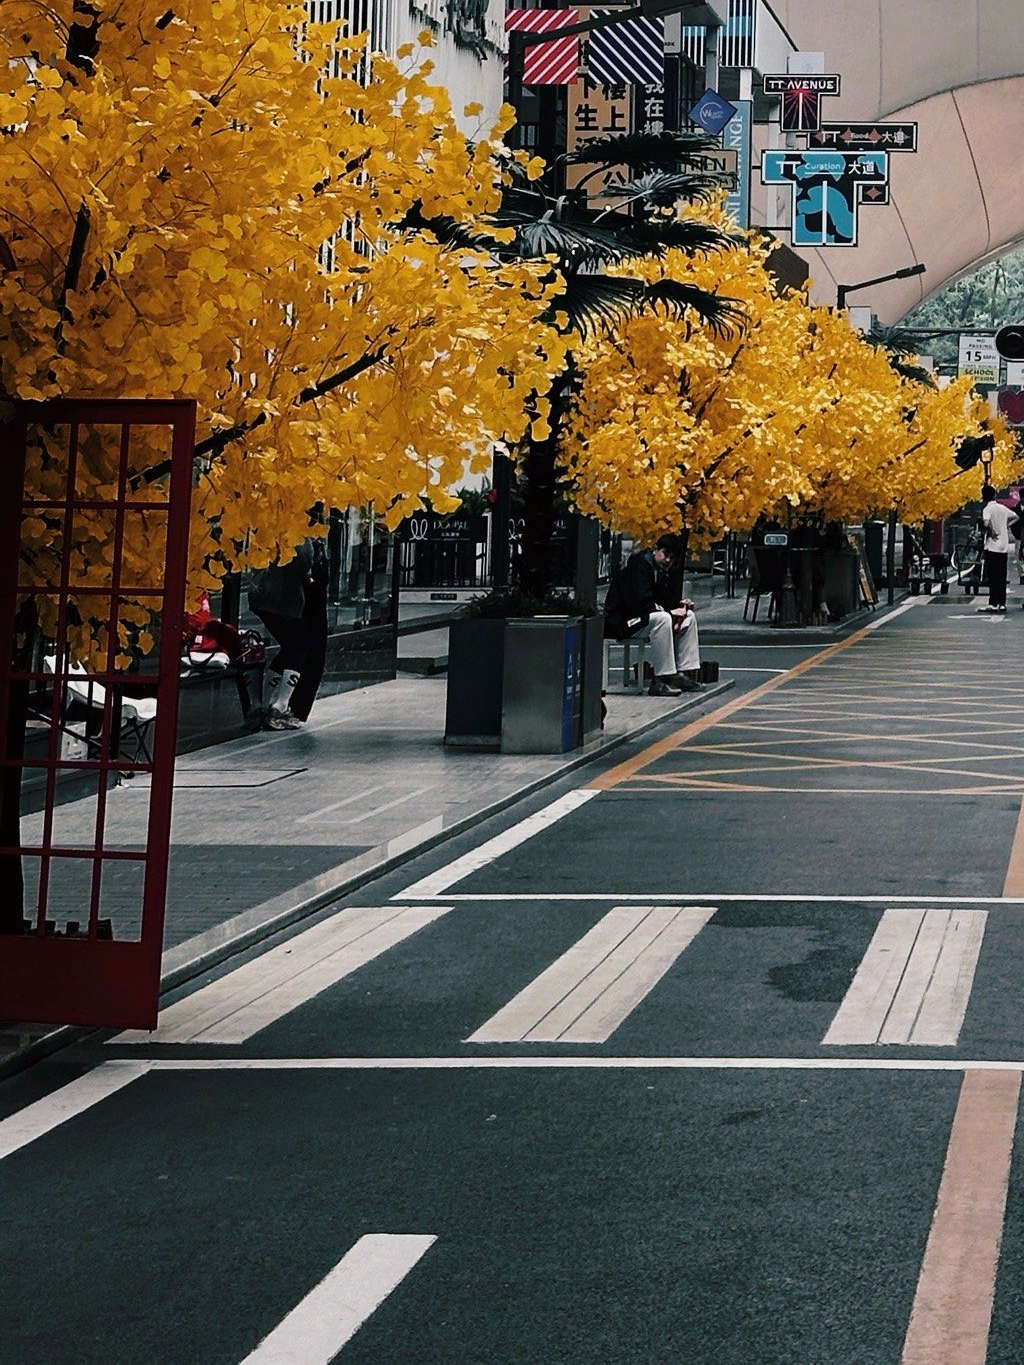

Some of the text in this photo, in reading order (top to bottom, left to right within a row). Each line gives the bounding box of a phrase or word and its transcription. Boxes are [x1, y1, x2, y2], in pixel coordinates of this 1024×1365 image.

[787, 80, 835, 90] AVENUE
[881, 131, 905, 143] 大道
[776, 161, 801, 175] TT
[848, 160, 875, 175] 大道
[965, 351, 982, 362] 15
